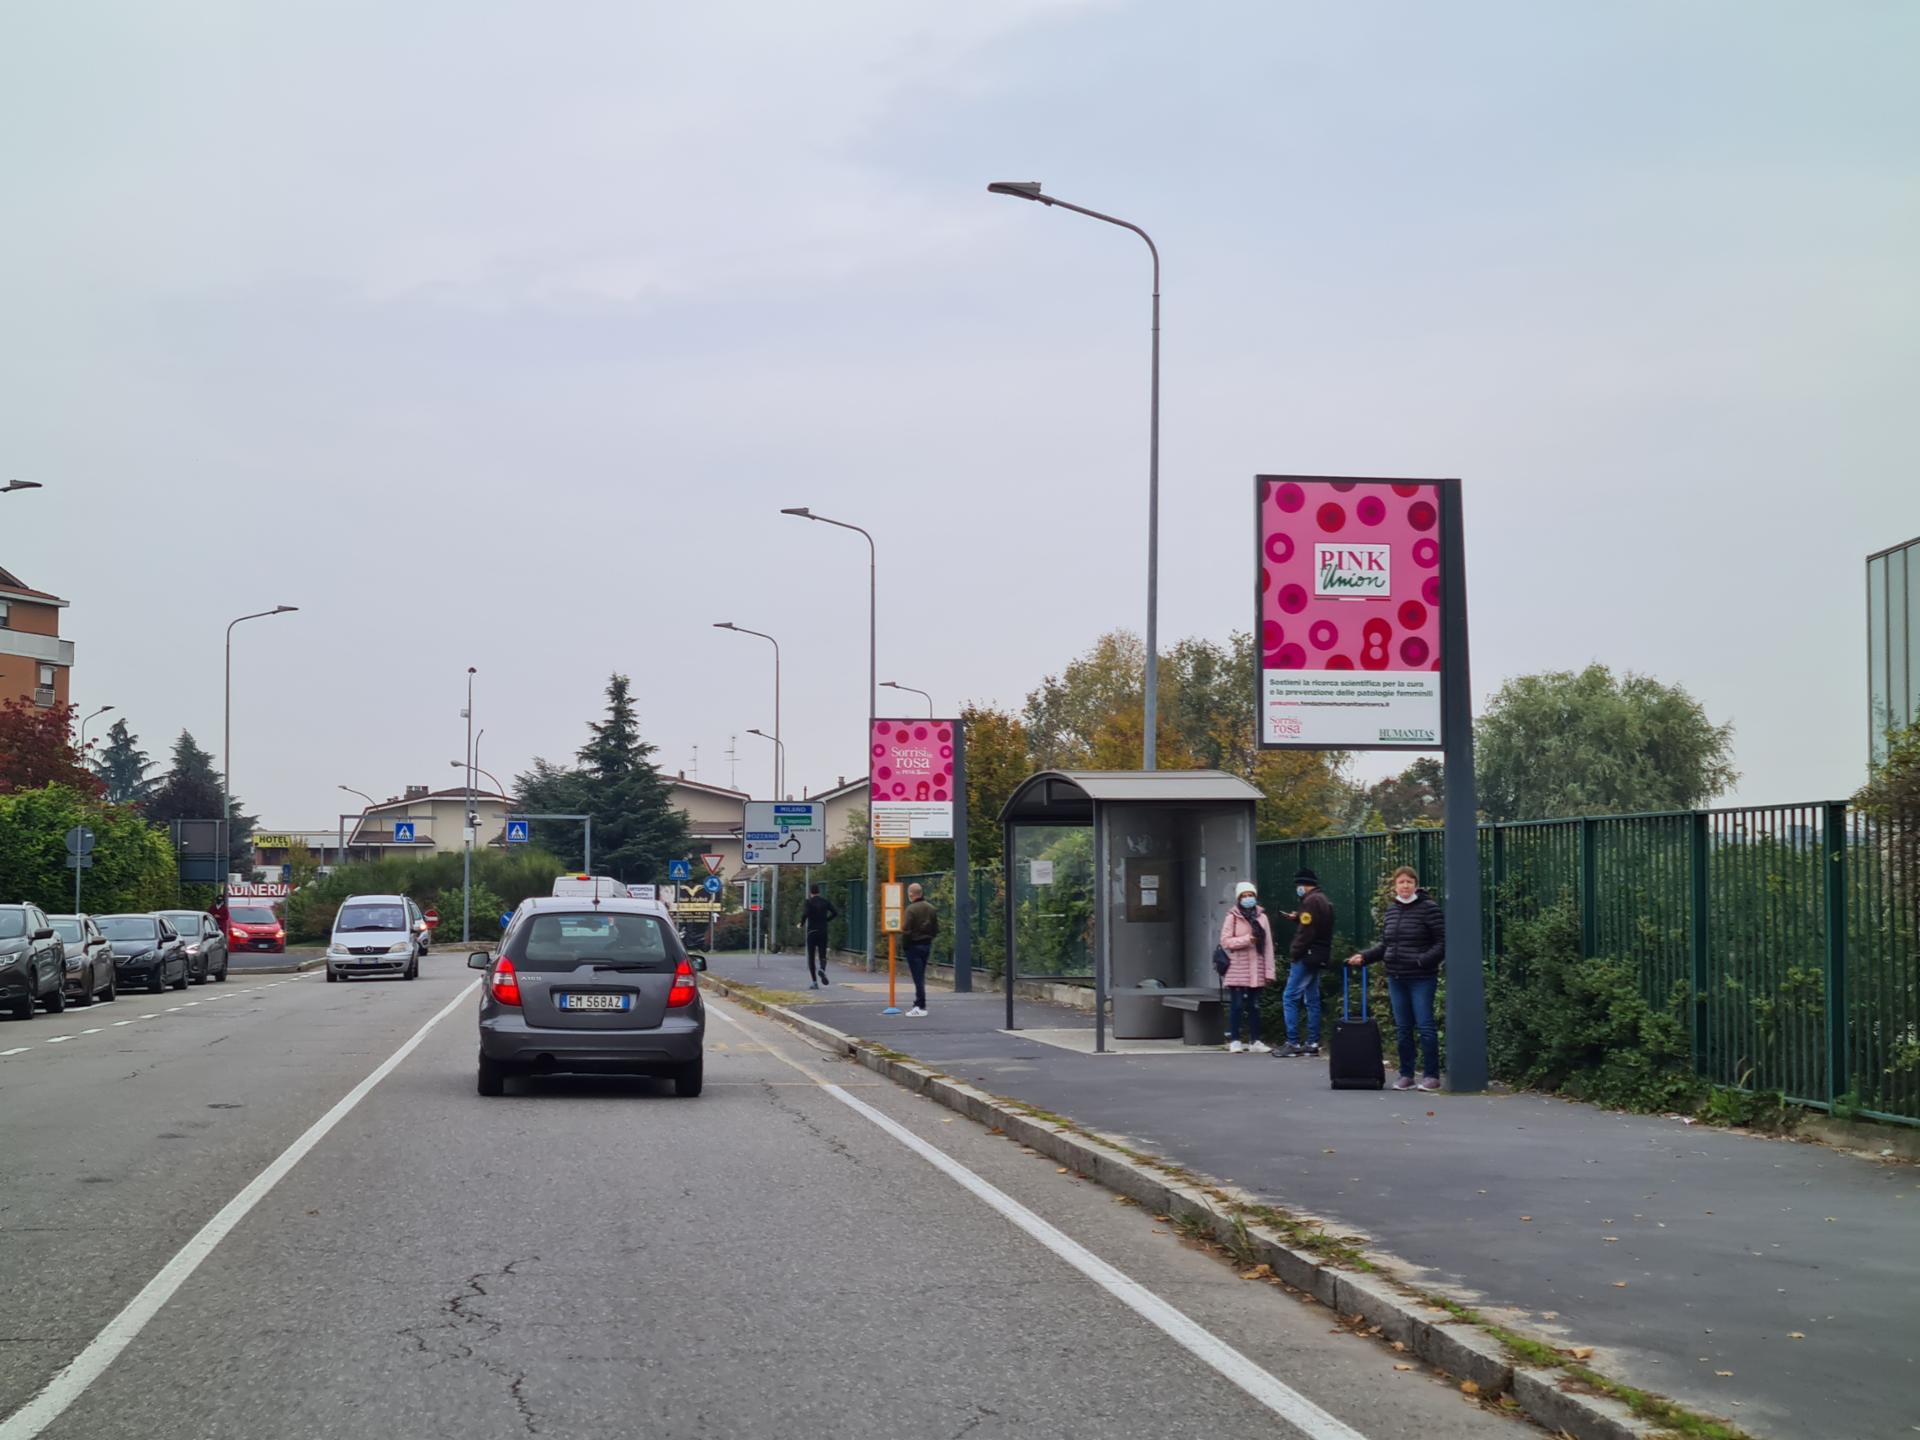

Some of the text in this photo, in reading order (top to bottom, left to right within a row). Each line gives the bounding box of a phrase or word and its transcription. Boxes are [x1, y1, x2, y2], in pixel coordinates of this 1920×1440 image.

[1320, 551, 1385, 571] PINK
[1321, 564, 1385, 590] Union
[1357, 690, 1395, 698] patologie
[1273, 724, 1301, 734] rosa
[1379, 729, 1434, 738] HUMANITAS
[891, 746, 928, 757] Sorrisi
[896, 757, 930, 769] rosa
[568, 996, 621, 1008] EM 568AZ
